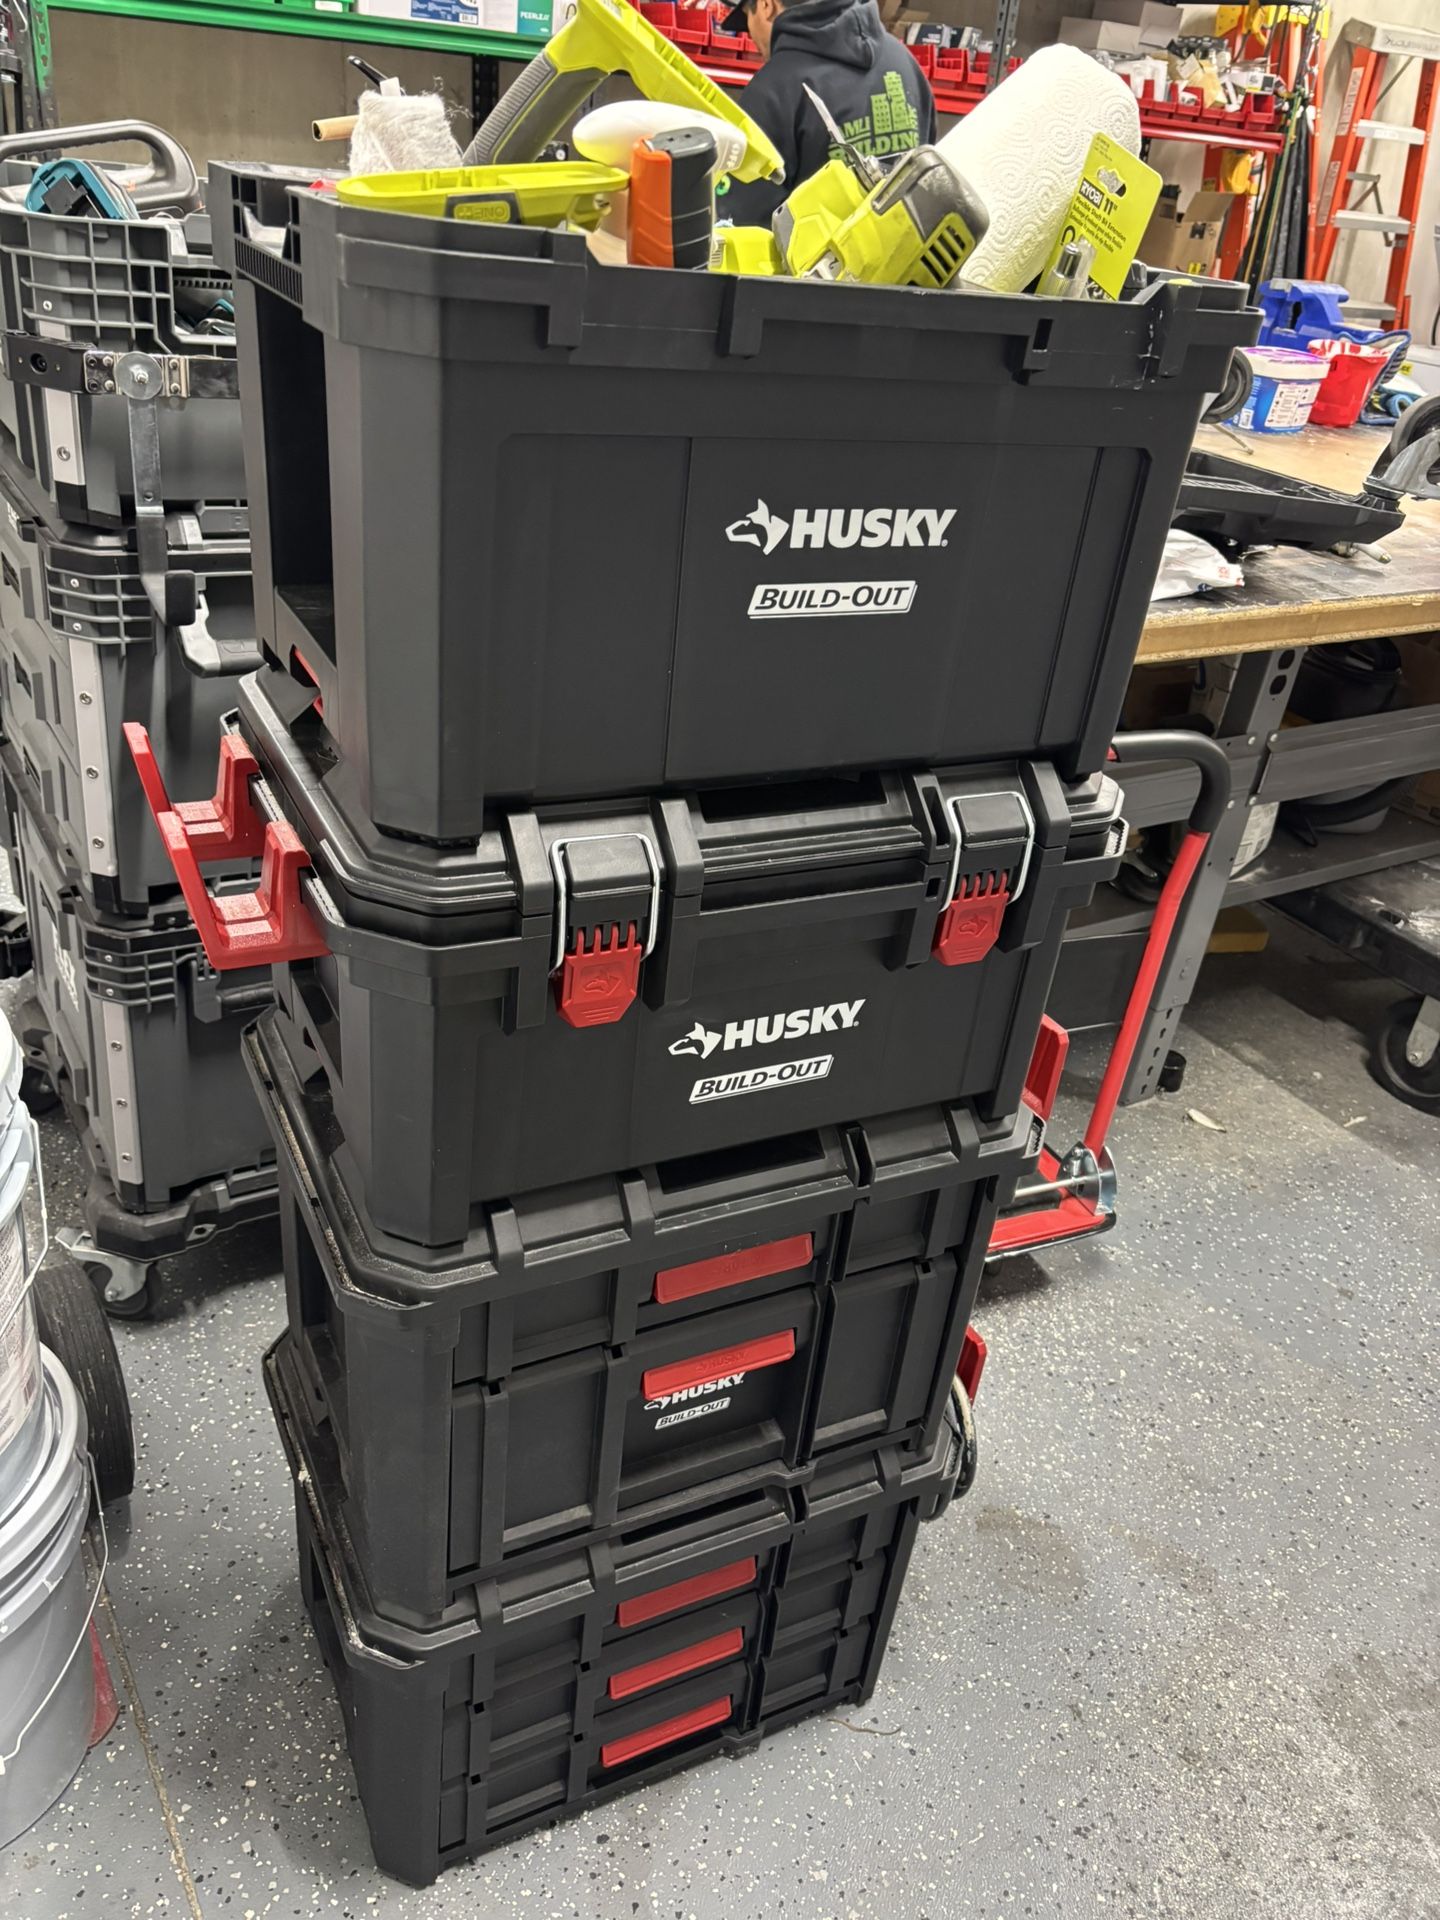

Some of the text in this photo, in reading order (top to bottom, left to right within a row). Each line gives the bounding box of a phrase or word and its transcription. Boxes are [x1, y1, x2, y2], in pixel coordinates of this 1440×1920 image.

[1080, 180, 1103, 207] RYOBI
[790, 508, 957, 549] HUSKY
[755, 585, 910, 611] BUILD-OUT
[723, 999, 866, 1051] HUSKY
[694, 1058, 828, 1098] BUILD-OUT
[658, 1400, 727, 1427] BUILD-OUT
